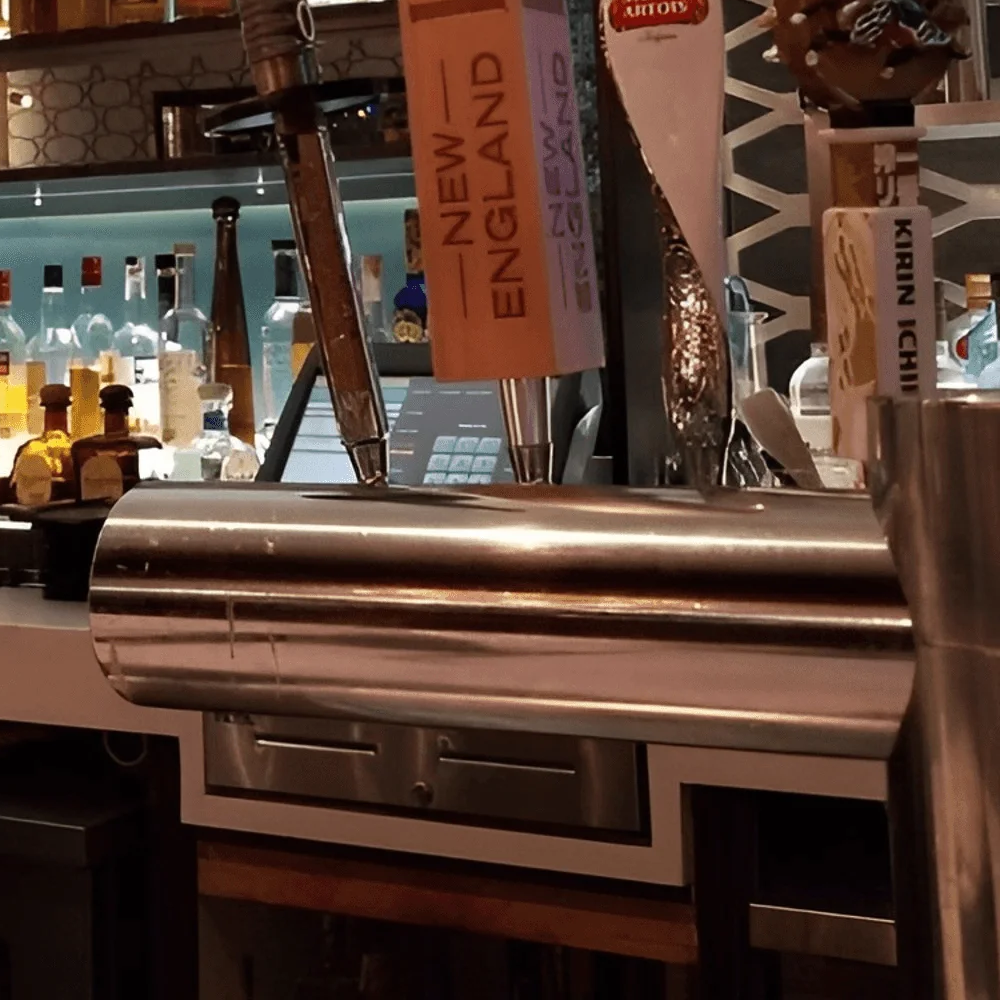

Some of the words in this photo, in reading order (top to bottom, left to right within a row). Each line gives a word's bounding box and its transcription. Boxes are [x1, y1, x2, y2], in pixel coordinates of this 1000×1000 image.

[432, 132, 475, 247] NEW
[470, 51, 526, 321] ENGLAND
[894, 218, 917, 307] KIRIN
